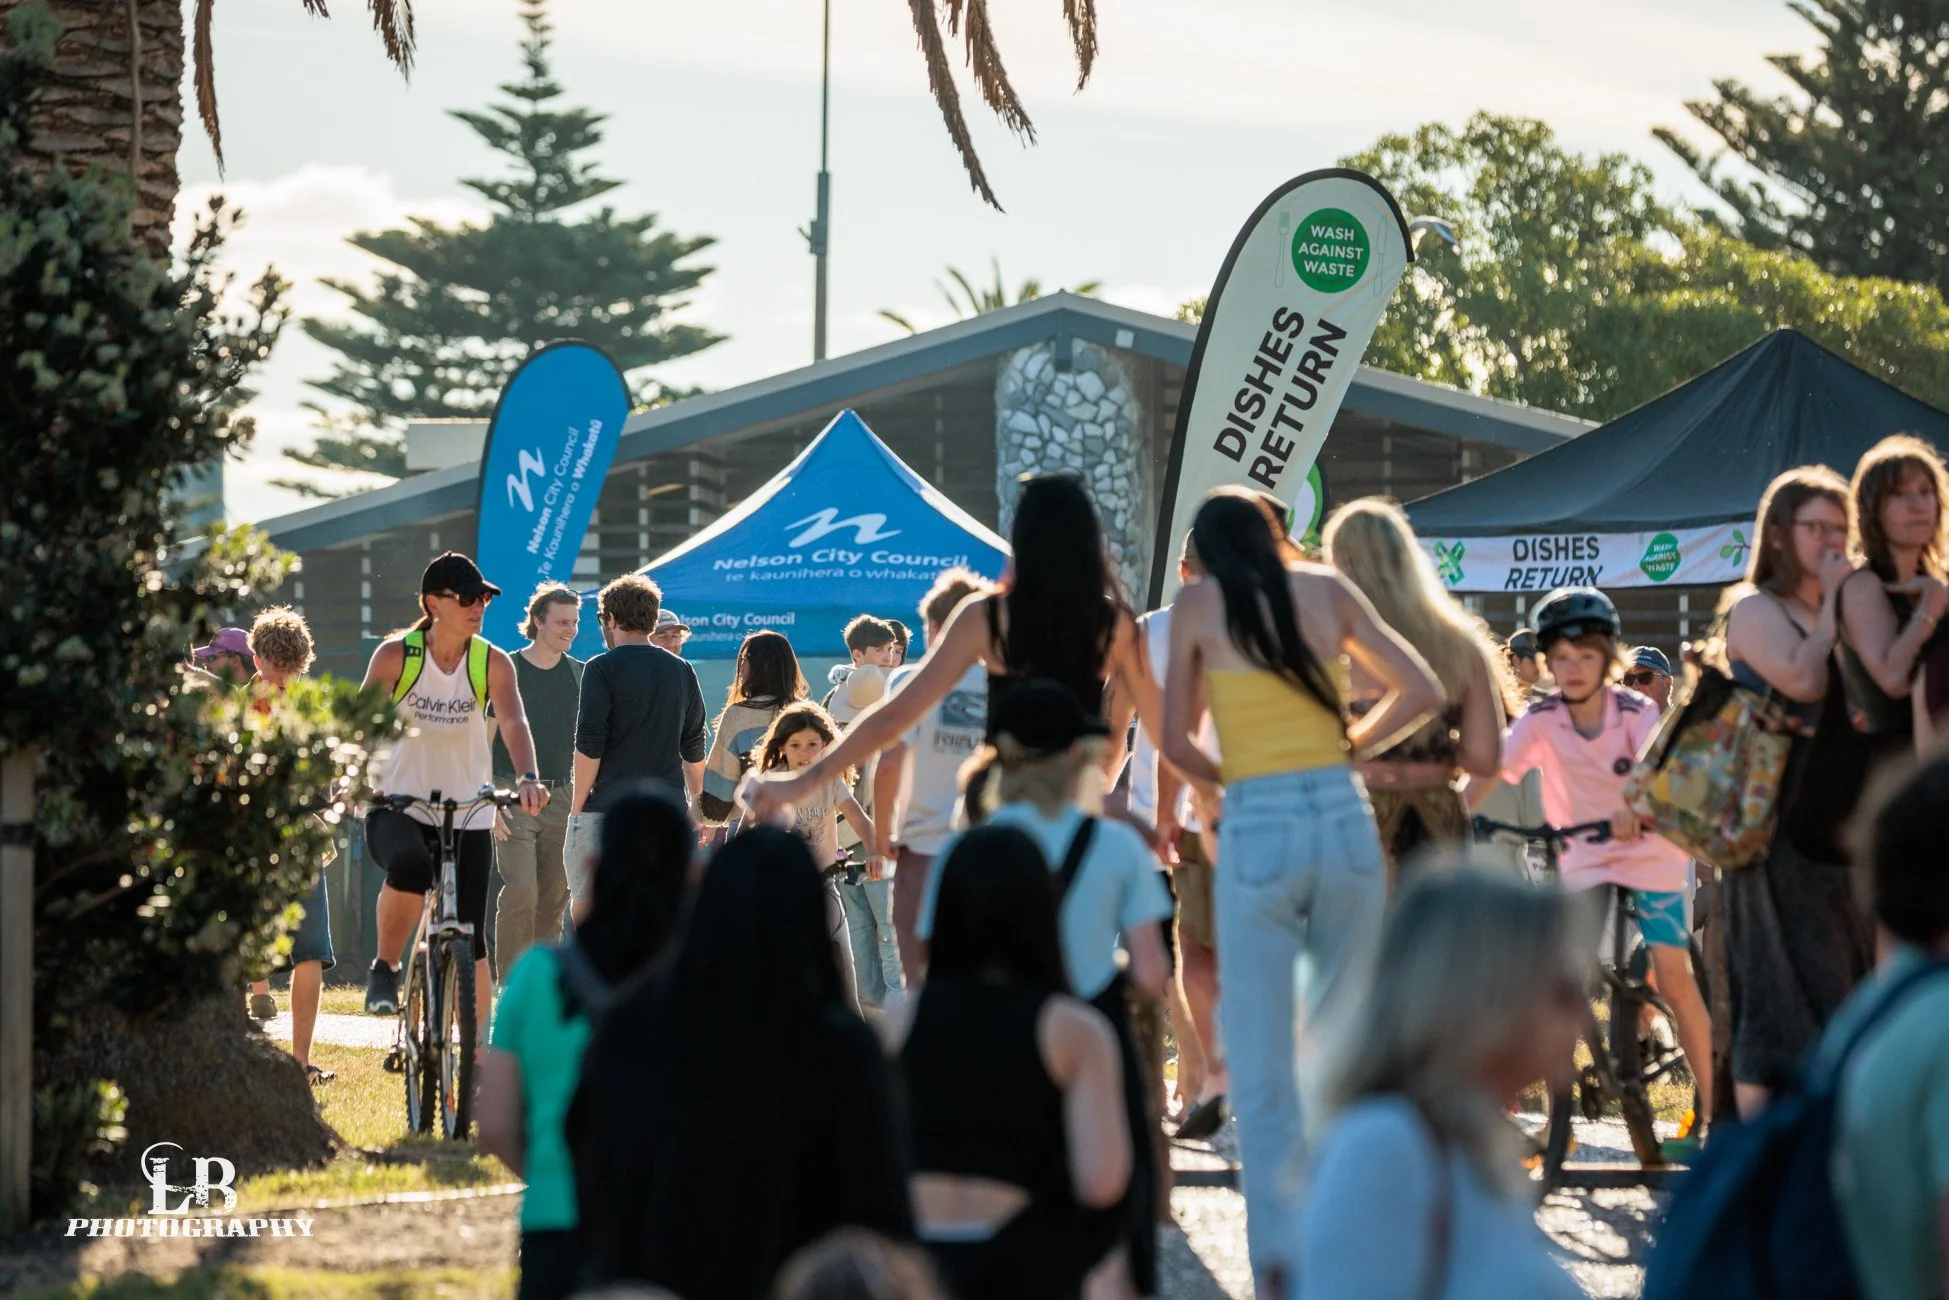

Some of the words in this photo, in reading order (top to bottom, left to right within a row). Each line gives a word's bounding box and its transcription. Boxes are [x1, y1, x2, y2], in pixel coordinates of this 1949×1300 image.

[1311, 224, 1354, 241] WASH
[1298, 242, 1364, 260] AGAINST
[1304, 260, 1355, 277] WASTE
[1212, 306, 1305, 463] DISHES
[1248, 318, 1348, 489] RETURN
[526, 507, 552, 554] Nelson
[544, 478, 564, 506] City
[554, 426, 580, 477] Council
[544, 493, 575, 560] Kaunihera
[571, 482, 580, 493] o
[1513, 536, 1600, 561] DISHES
[713, 553, 803, 570] Nelson
[811, 549, 864, 566] City
[870, 550, 968, 568] Council
[725, 571, 745, 582] te
[750, 568, 845, 581] kaunihera
[849, 569, 862, 579] o
[865, 569, 940, 581] whakat
[1504, 565, 1604, 589] RETURN
[679, 613, 709, 627] lson
[712, 612, 741, 629] City
[743, 612, 796, 626] Council
[407, 692, 447, 713] Calvin
[414, 711, 469, 725] Performance
